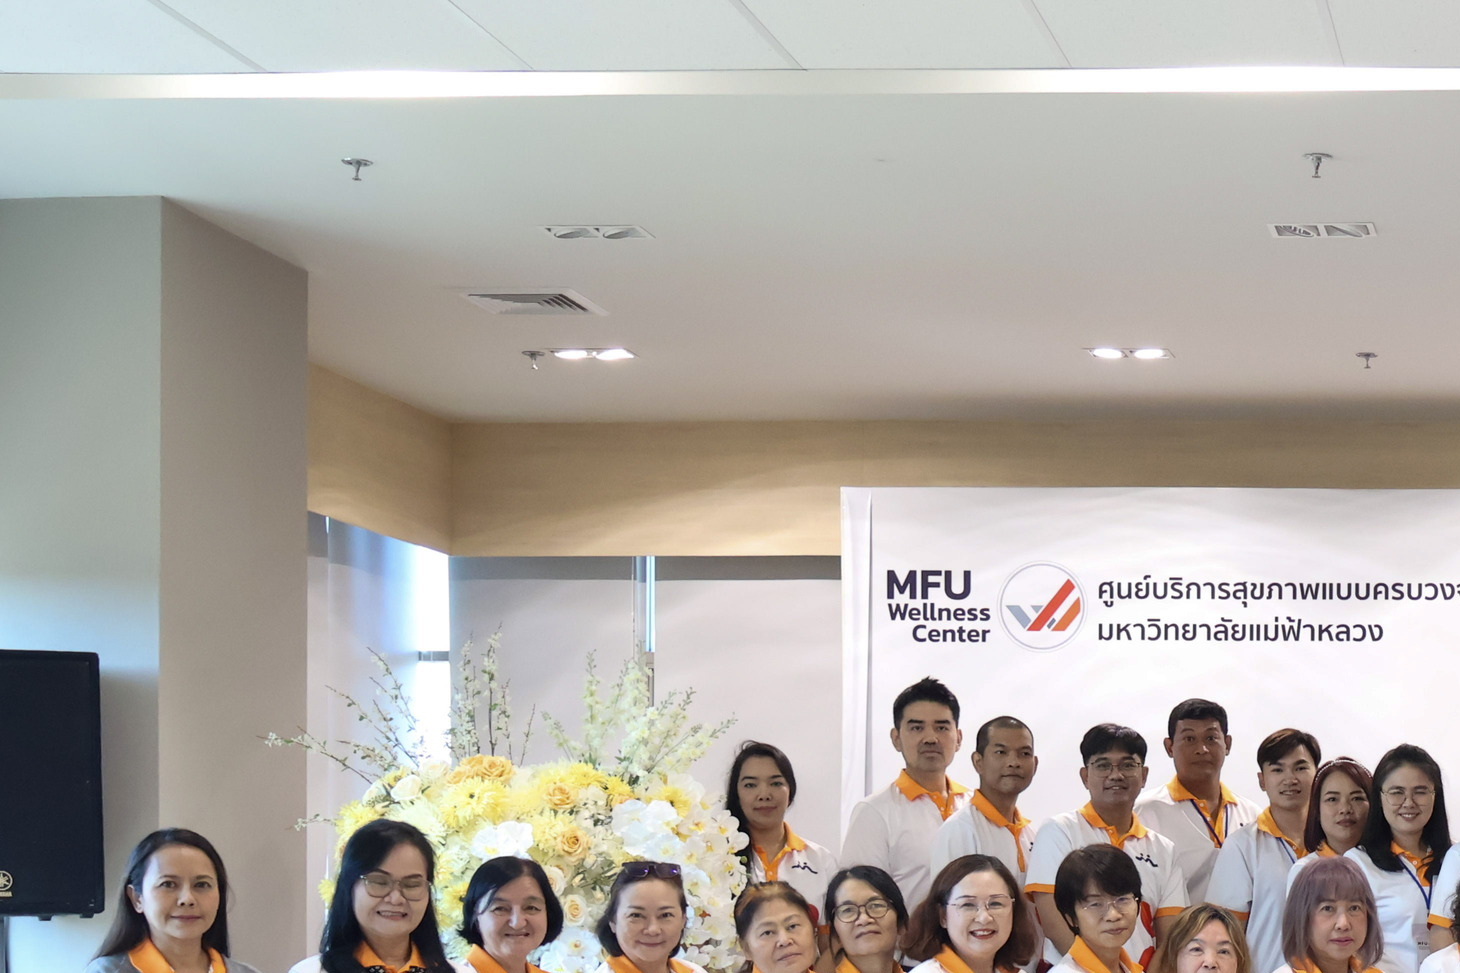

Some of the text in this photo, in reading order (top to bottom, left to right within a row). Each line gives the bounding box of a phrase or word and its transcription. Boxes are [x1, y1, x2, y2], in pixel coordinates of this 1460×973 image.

[886, 569, 972, 601] MFU
[887, 602, 991, 622] Wellness
[912, 624, 991, 643] Center
[1098, 616, 1384, 642] มหาวิทยาลัยแม่ฟ้าหลวง
